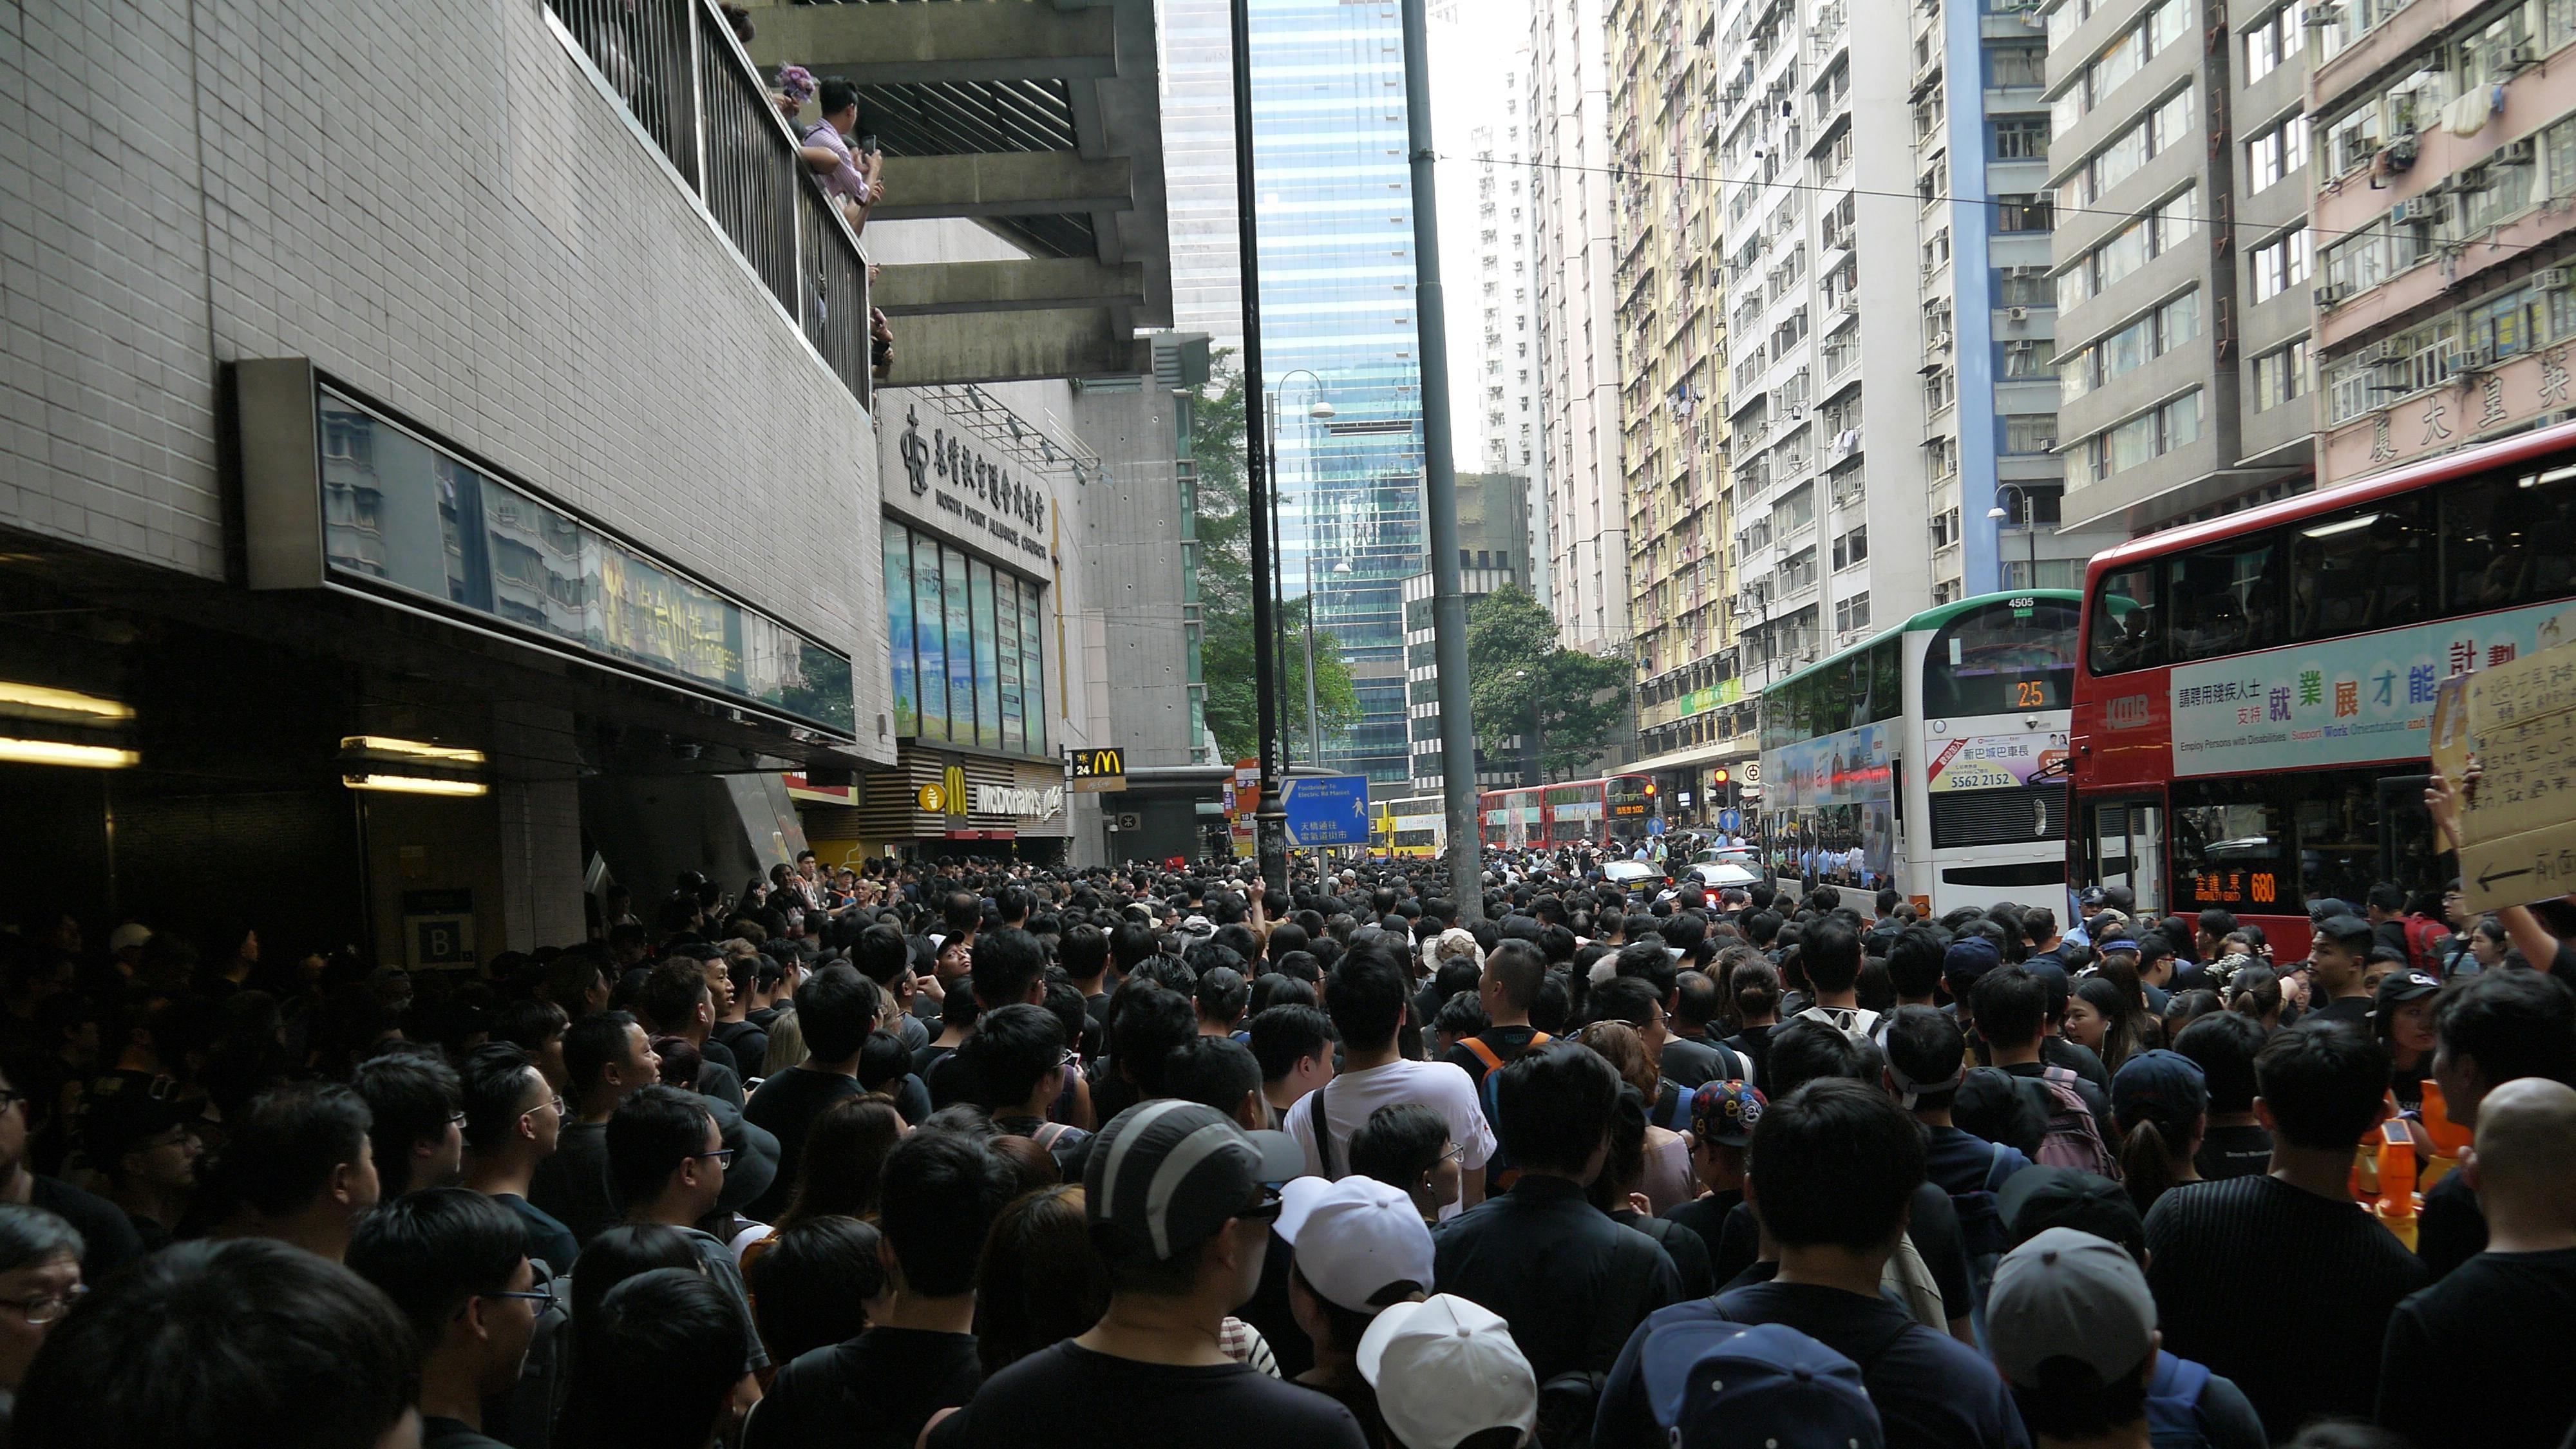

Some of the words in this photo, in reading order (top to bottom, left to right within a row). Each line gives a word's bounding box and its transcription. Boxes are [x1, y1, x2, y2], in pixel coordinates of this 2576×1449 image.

[936, 488, 962, 516] NORTH
[965, 504, 986, 529] POINT
[989, 517, 1018, 546] ALLIANCE
[1021, 536, 1046, 560] CHURCH
[2009, 597, 2034, 607] 4505
[2016, 680, 2043, 707] 25
[2179, 678, 2261, 708] 請聘用殘疾人士
[2107, 694, 2149, 732] KMB
[2237, 705, 2261, 725] 支持
[2181, 742, 2204, 752] Employ
[2205, 739, 2231, 749] Persons
[2233, 736, 2246, 746] with
[2248, 732, 2286, 744] Disabilities
[2291, 729, 2322, 741] Support
[2324, 724, 2348, 738] Work
[2351, 719, 2405, 736] Orientation
[2407, 716, 2426, 730] and
[1964, 744, 2029, 761] 新巴城巴車長
[1077, 765, 1090, 775] 24
[1951, 775, 1978, 788] 5562
[1982, 773, 2009, 786] 2152
[977, 784, 1041, 815] McDonald's
[2251, 873, 2276, 902] 680
[432, 928, 449, 956] B
